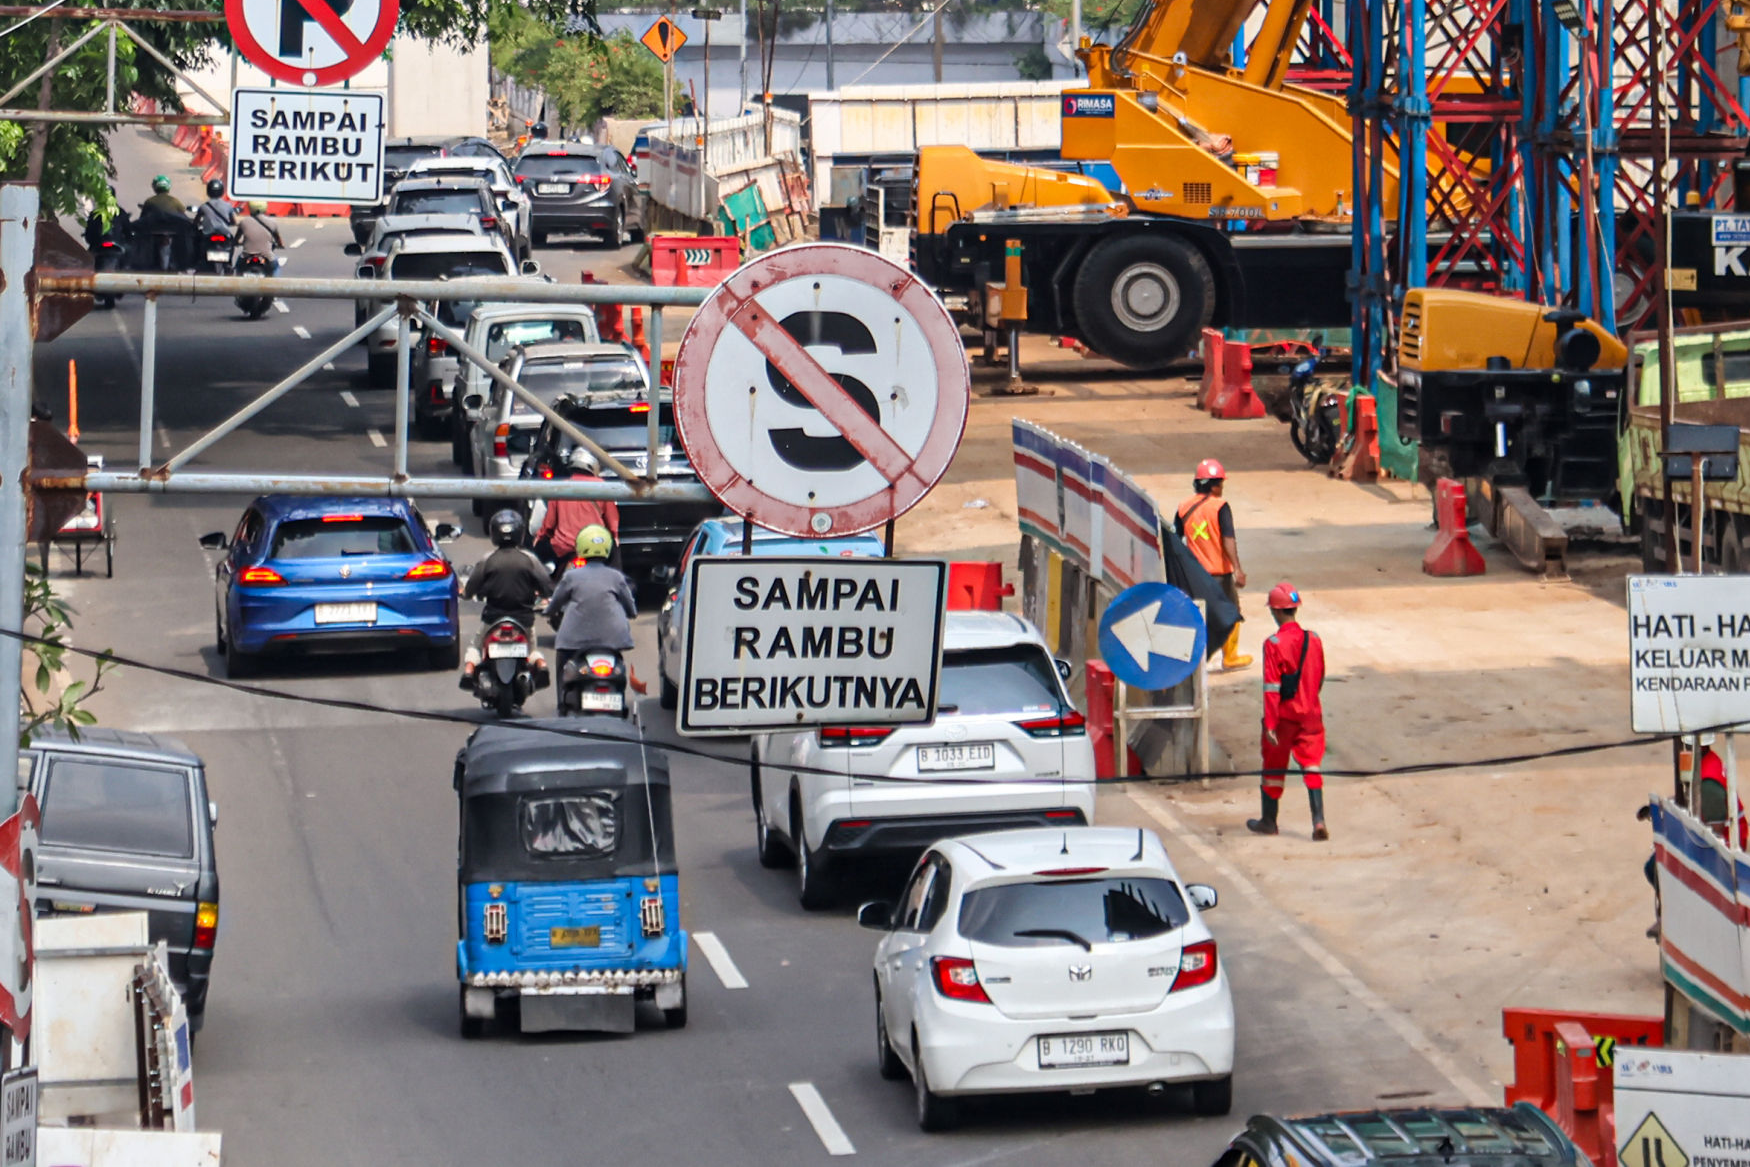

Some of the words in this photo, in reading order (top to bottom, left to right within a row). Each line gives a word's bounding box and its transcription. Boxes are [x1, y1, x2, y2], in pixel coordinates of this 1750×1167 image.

[251, 109, 367, 132] SAMPAI
[252, 134, 362, 158] RAMBU
[237, 159, 374, 183] BERIKUT
[1715, 219, 1730, 231] PT.
[765, 310, 881, 473] S
[733, 576, 900, 612] SAMPAI
[1633, 614, 1696, 638] HATI
[733, 626, 895, 660] RAMBU
[1635, 649, 1726, 668] KELUAR
[694, 675, 926, 711] BERIKUTNYA
[1636, 677, 1739, 692] KENDARAAN
[920, 749, 928, 762] B
[1042, 1039, 1051, 1056] B
[1061, 1038, 1093, 1055] 1290
